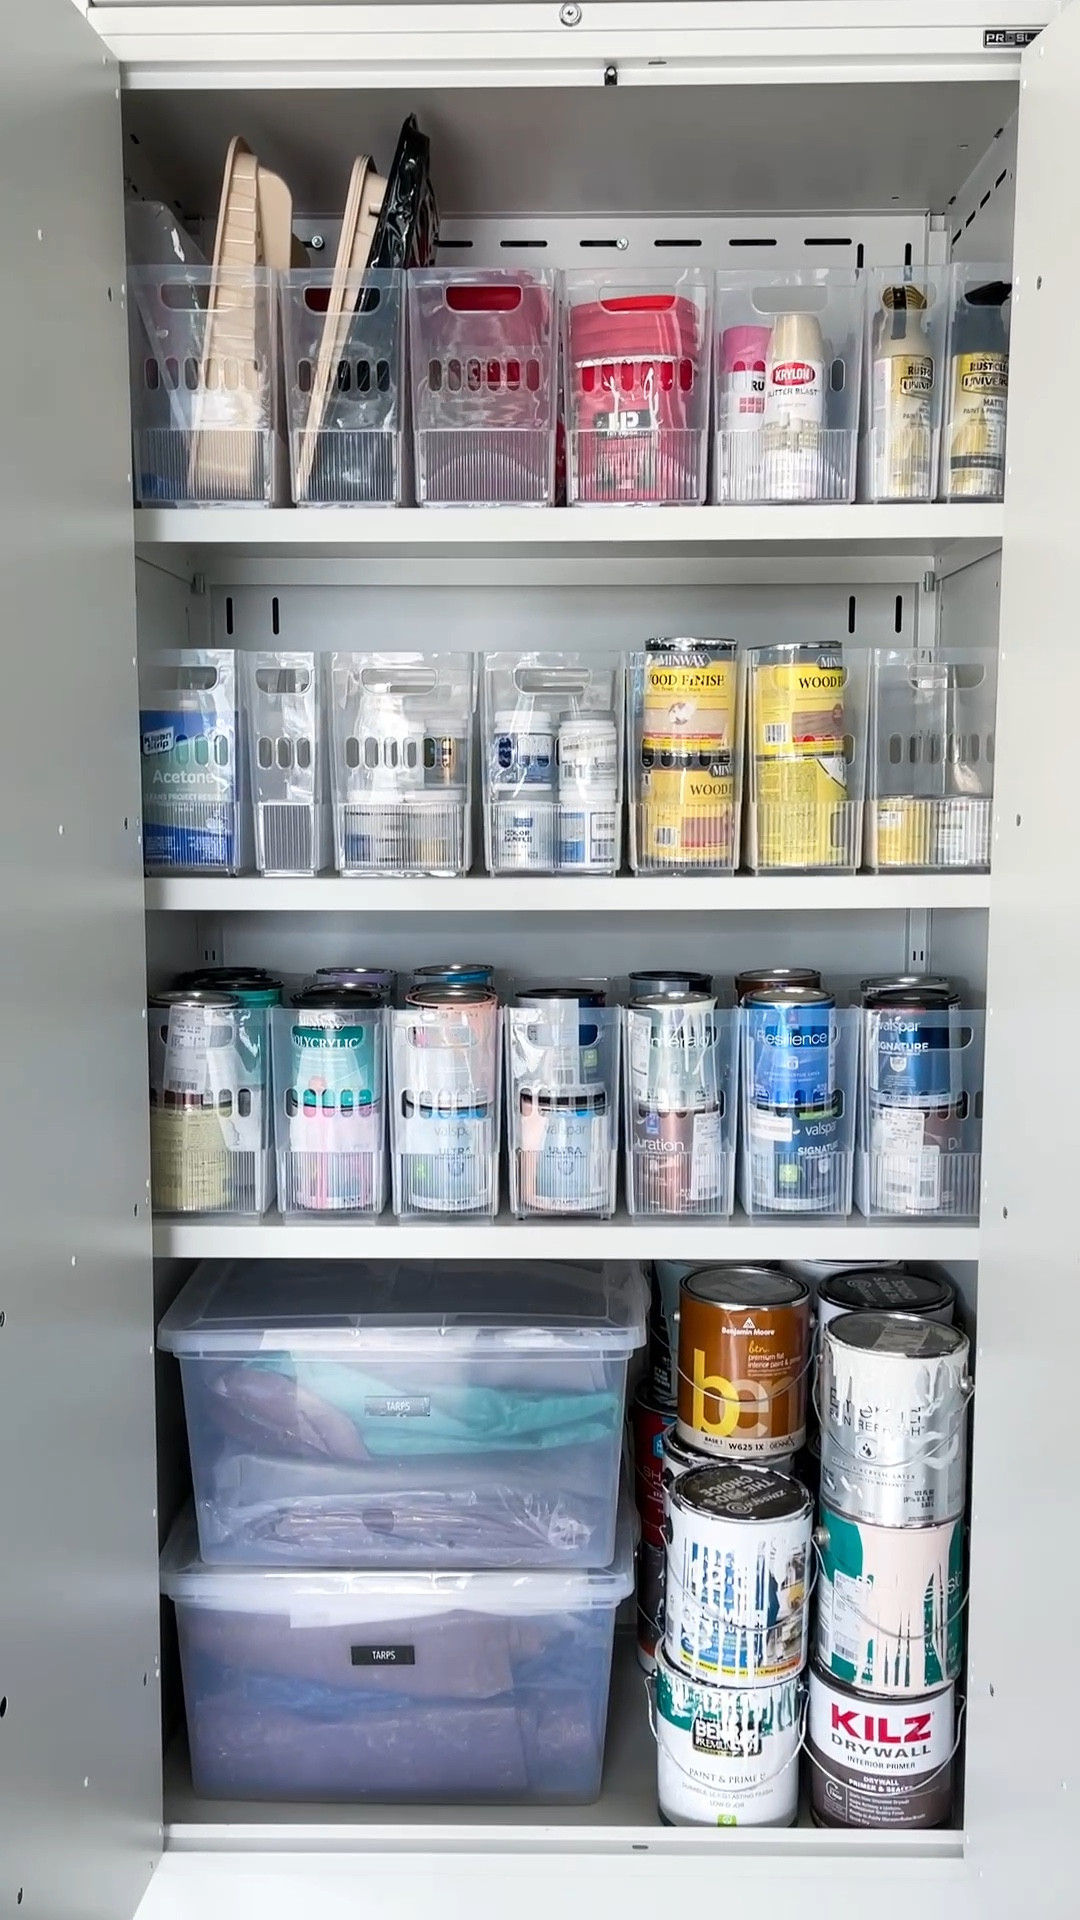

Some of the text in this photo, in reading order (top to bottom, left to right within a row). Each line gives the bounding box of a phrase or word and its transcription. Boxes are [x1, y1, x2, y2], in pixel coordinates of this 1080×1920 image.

[775, 367, 812, 382] KRYLON
[659, 654, 706, 667] MINWAX
[650, 674, 677, 686] OOD
[799, 677, 837, 688] WOOD
[152, 769, 216, 784] Acetone
[690, 784, 727, 795] WOOD
[293, 1036, 358, 1048] OLYCRYLIC
[721, 1326, 775, 1336] Benjamin Moore
[386, 1401, 410, 1411] TARPS
[728, 1442, 752, 1451] W625
[699, 1476, 753, 1497] CHOICE
[743, 1479, 775, 1494] THE
[372, 1651, 396, 1660] TARPS
[832, 1702, 931, 1743] KILZ
[831, 1733, 931, 1758] DRYWALL
[848, 1755, 884, 1769] INTERIOR
[689, 1768, 715, 1781] PAINT
[718, 1775, 726, 1783] &
[863, 1776, 899, 1786] DRYWALL
[849, 1778, 876, 1791] PRIMER
